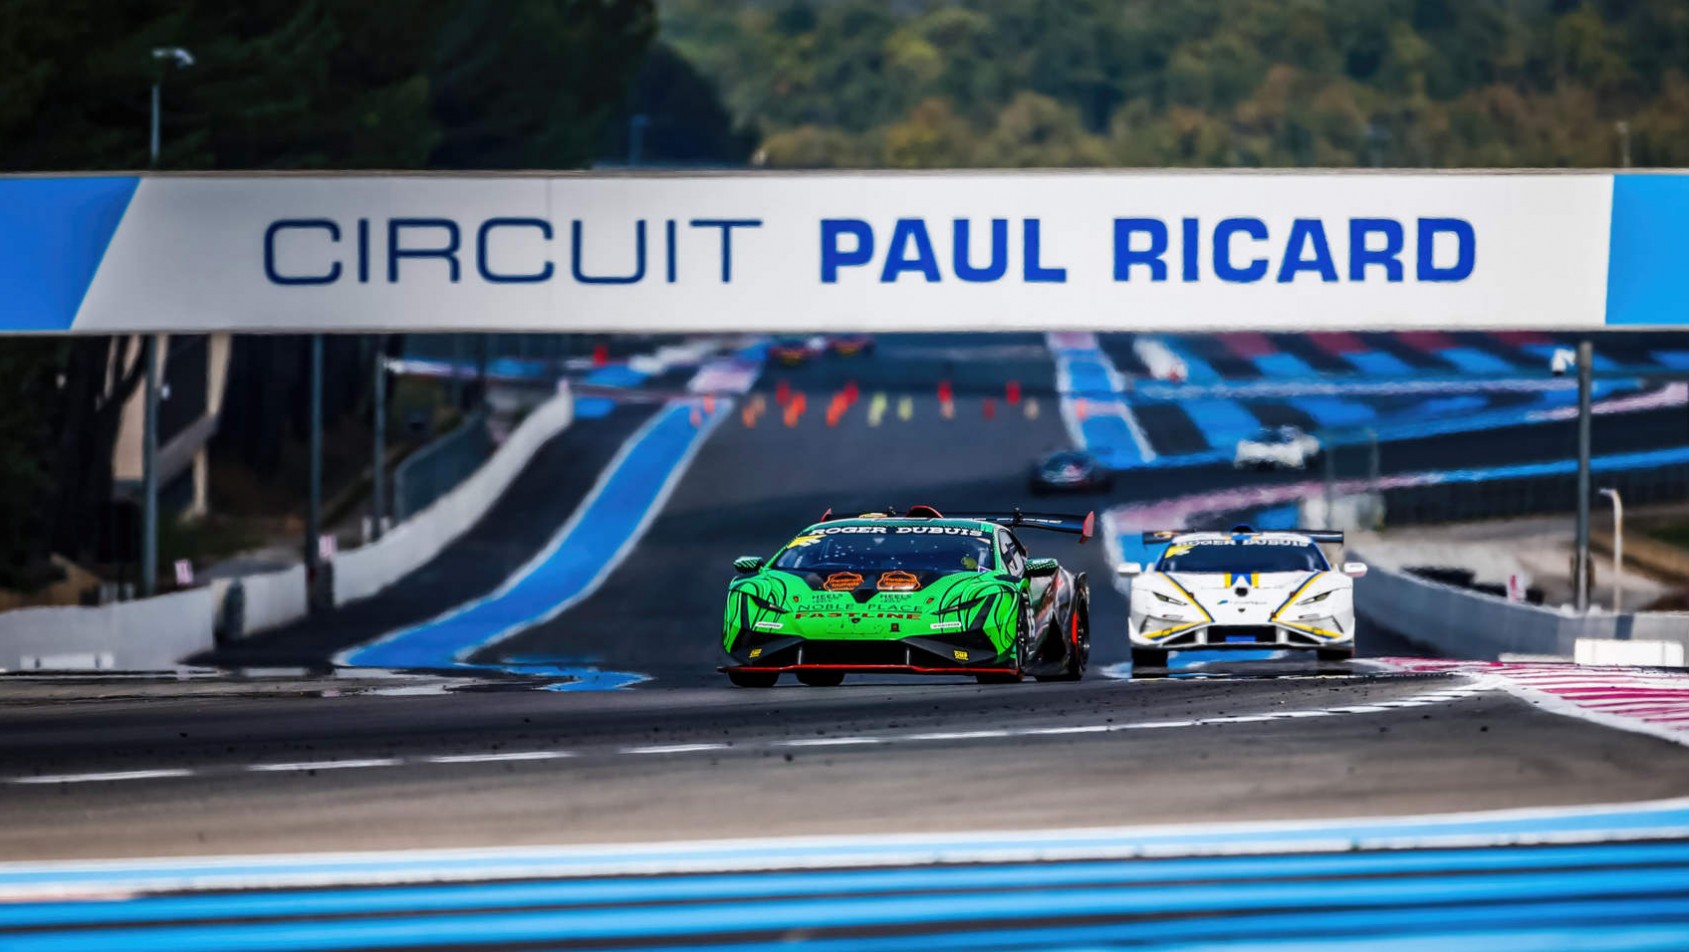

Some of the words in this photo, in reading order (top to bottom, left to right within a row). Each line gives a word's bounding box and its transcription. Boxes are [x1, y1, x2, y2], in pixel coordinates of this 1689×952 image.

[262, 218, 763, 286] CIRCUIT
[820, 218, 1067, 284] PAUL
[1113, 217, 1476, 284] RICARD
[809, 526, 887, 536] ROGER
[896, 526, 983, 537] DUBUIS
[797, 603, 855, 611] NOBLE
[868, 603, 923, 612] PLACE
[795, 612, 922, 620] FASTLINE
